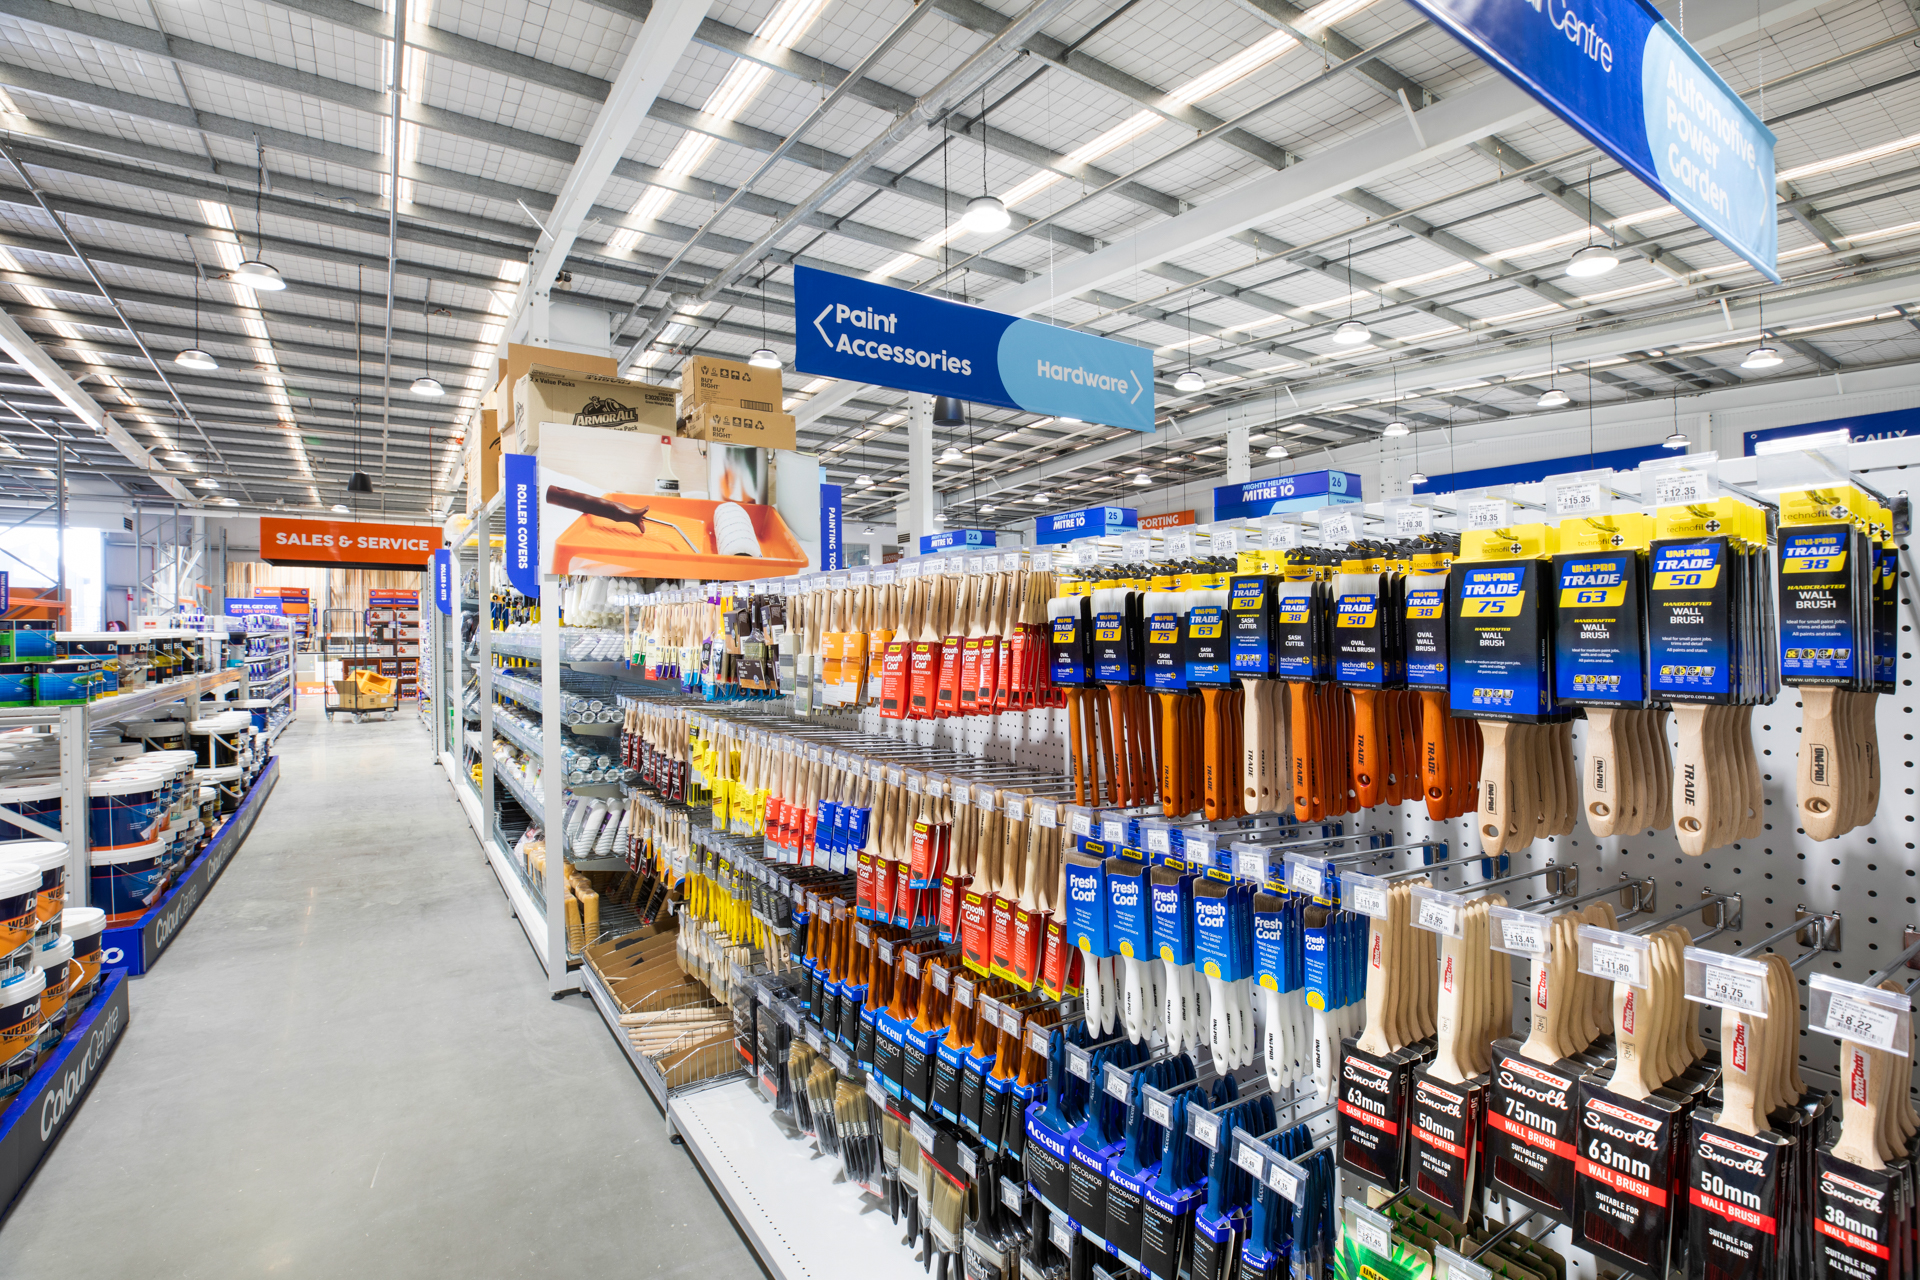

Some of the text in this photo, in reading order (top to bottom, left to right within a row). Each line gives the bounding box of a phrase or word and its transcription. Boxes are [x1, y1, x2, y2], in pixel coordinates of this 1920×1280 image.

[1666, 59, 1756, 170] Automotive
[1666, 96, 1720, 170] Power
[1668, 143, 1730, 219] Garden
[836, 303, 898, 334] Paint
[835, 334, 972, 376] Accessories
[540, 378, 556, 386] Value
[558, 380, 575, 388] Packs
[1037, 359, 1128, 394] Hardware
[1242, 478, 1294, 491] MIGHTY HELPFUL
[1242, 485, 1295, 502] MITRE 10
[1331, 477, 1342, 488] 26
[517, 484, 528, 570] ROLLER COVERS
[1053, 517, 1086, 530] MITRE 10
[1108, 512, 1118, 520] 25
[276, 533, 429, 551] SALES & SERVICE
[931, 539, 946, 547] MITRE
[1786, 546, 1840, 556] TRADE
[1657, 559, 1713, 570] TRADE
[1800, 559, 1830, 570] 38
[1465, 584, 1519, 595] TRADE
[1563, 574, 1621, 586] TRADE
[1670, 574, 1701, 586] 50
[1234, 589, 1260, 597] TRADE
[1577, 591, 1607, 603] 63
[1796, 600, 1836, 609] BRUSH
[1798, 591, 1833, 599] WALL
[1340, 604, 1373, 612] TRADE
[1416, 608, 1433, 616] 38
[1478, 601, 1506, 613] 75
[1198, 627, 1213, 636] 63
[1348, 616, 1366, 625] 50
[1670, 616, 1704, 624] BRUSH
[1685, 764, 1695, 806] TRADE
[1070, 874, 1097, 889] Fresh
[1072, 888, 1096, 902] Coat
[1196, 902, 1225, 916] Fresh
[1198, 914, 1225, 928] Coat
[1255, 917, 1282, 930] Fresh
[1256, 928, 1281, 941] Coat
[878, 1018, 903, 1044] Accent
[876, 1034, 901, 1058] PROJECT
[40, 1006, 119, 1142] ColourCentre
[1344, 1066, 1390, 1094] Smooth
[1347, 1087, 1386, 1117] 63mm
[1498, 1071, 1569, 1111] Smooth
[1416, 1090, 1462, 1119] Smooth
[1346, 1105, 1385, 1129] SASH CUTTER
[1419, 1112, 1455, 1142] 50mm
[1506, 1097, 1558, 1136] 75mm
[1028, 1120, 1066, 1157] Accent
[1419, 1130, 1456, 1154] SASH CUTTER
[1505, 1120, 1556, 1151] WALL BRUSH
[1584, 1111, 1659, 1151] Smooth
[1028, 1140, 1065, 1173] DECORATOR
[1512, 1142, 1548, 1165] SUITABLE FOR
[1514, 1153, 1544, 1172] ALL PAINTS
[1588, 1138, 1650, 1181] 63mm
[1698, 1144, 1766, 1178] Smooth
[1588, 1163, 1650, 1198] WALL BRUSH
[1701, 1171, 1761, 1211] 50mm
[1146, 1190, 1175, 1213] Accent
[1820, 1181, 1883, 1215] Smooth
[1146, 1204, 1173, 1225] DECORATOR
[1701, 1194, 1761, 1226] WALL BRUSH
[1825, 1206, 1878, 1242] 38mm
[1824, 1225, 1878, 1253] WALL BRUSH
